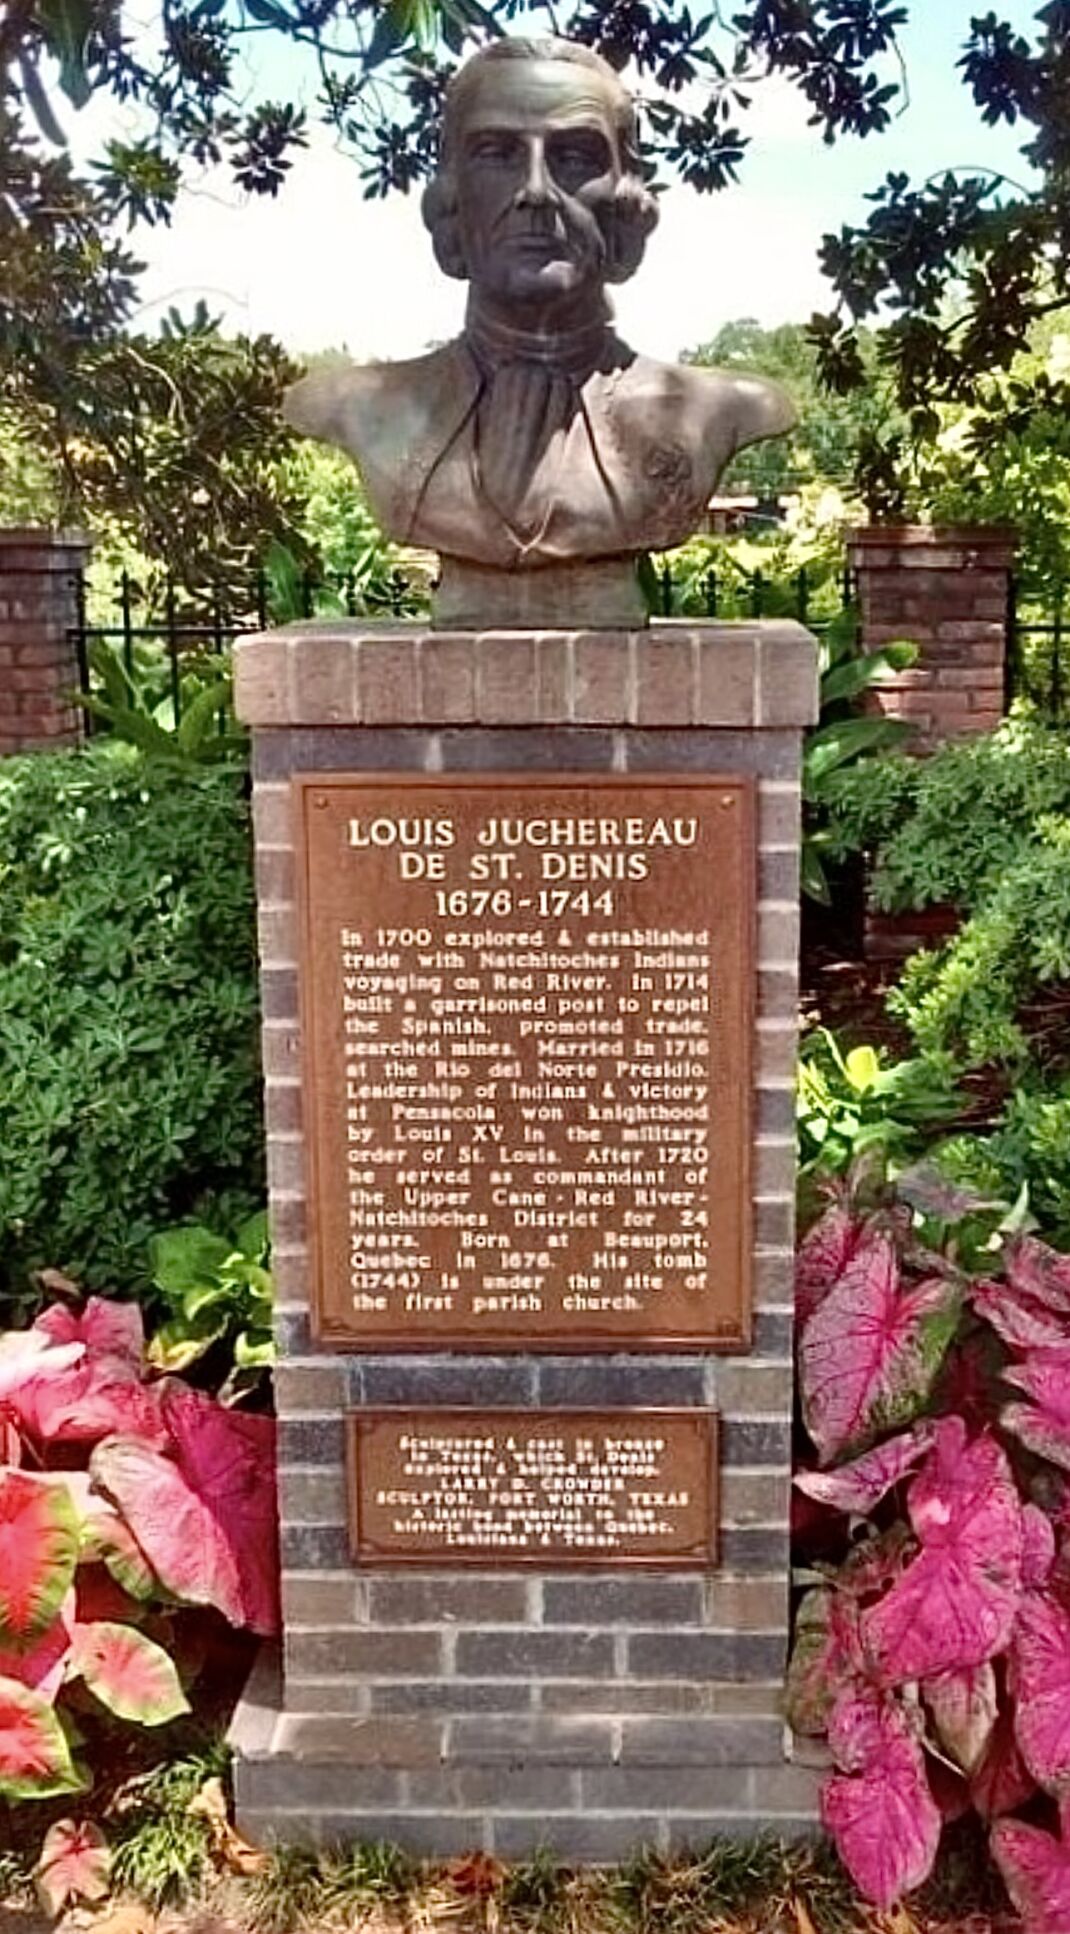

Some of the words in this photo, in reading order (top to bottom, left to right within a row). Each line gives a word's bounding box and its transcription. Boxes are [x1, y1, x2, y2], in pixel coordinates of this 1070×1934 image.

[348, 818, 455, 847] LOUIS
[477, 817, 697, 846] JUCHEREAU
[399, 851, 446, 880] DE
[468, 852, 523, 880] ST.
[541, 852, 648, 881] DENIS
[339, 927, 363, 947] In
[377, 928, 432, 947] 1700
[444, 929, 545, 950] explored
[586, 928, 710, 947] established
[341, 951, 401, 970] trade
[417, 950, 466, 969] with
[479, 951, 620, 969] Natchitoches
[634, 950, 711, 969] Indians
[342, 972, 443, 995] voyaging
[453, 977, 480, 991] on
[492, 973, 534, 991] Red
[632, 972, 653, 991] In
[665, 972, 709, 991] 1714
[343, 994, 393, 1013] built
[403, 998, 417, 1013] a
[430, 995, 547, 1017] garrisoned
[558, 996, 604, 1016] post
[618, 996, 640, 1013] to
[651, 994, 709, 1016] repel
[344, 1016, 380, 1035] the
[519, 1018, 624, 1037] promoted
[343, 1039, 441, 1057] searched
[537, 1039, 624, 1057] Married
[634, 1038, 655, 1057] in
[664, 1038, 710, 1056] 1716
[345, 1061, 367, 1079] at
[383, 1060, 419, 1079] the
[435, 1060, 471, 1078] Rio
[487, 1060, 522, 1078] del
[537, 1061, 598, 1079] Norte
[346, 1081, 463, 1102] Leadership
[474, 1082, 498, 1100] of
[510, 1081, 587, 1100] Indians
[628, 1081, 709, 1102] victory
[346, 1104, 368, 1121] at
[392, 1102, 496, 1121] Pensacola
[521, 1106, 564, 1121] won
[587, 1103, 710, 1125] knighthood
[347, 1124, 375, 1144] by
[394, 1124, 452, 1142] Louis
[471, 1124, 504, 1142] XV
[524, 1125, 545, 1143] in
[566, 1125, 601, 1142] the
[621, 1125, 708, 1146] military
[347, 1146, 408, 1164] order
[422, 1146, 444, 1164] of
[585, 1146, 645, 1164] After
[658, 1144, 709, 1164] 1720
[347, 1166, 376, 1184] he
[396, 1168, 471, 1185] served
[489, 1171, 513, 1185] as
[533, 1167, 666, 1185] commandant
[684, 1166, 709, 1185] of
[349, 1188, 385, 1206] the
[404, 1187, 472, 1209] Upper
[491, 1188, 546, 1207] Cane
[574, 1188, 615, 1206] Red
[349, 1207, 489, 1228] Natchitoches
[514, 1209, 599, 1228] District
[623, 1210, 656, 1227] for
[680, 1209, 709, 1228] 24
[461, 1230, 511, 1249] Born
[547, 1232, 569, 1248] at
[350, 1251, 431, 1270] Quebec
[456, 1250, 476, 1270] in
[592, 1251, 629, 1270] His
[654, 1250, 708, 1269] tomb
[350, 1271, 421, 1290] (1744)
[441, 1272, 460, 1290] is
[482, 1273, 545, 1290] under
[567, 1273, 602, 1291] the
[624, 1272, 663, 1290] site
[684, 1271, 708, 1290] of
[352, 1292, 388, 1311] the
[405, 1292, 453, 1311] first
[472, 1293, 542, 1314] parish
